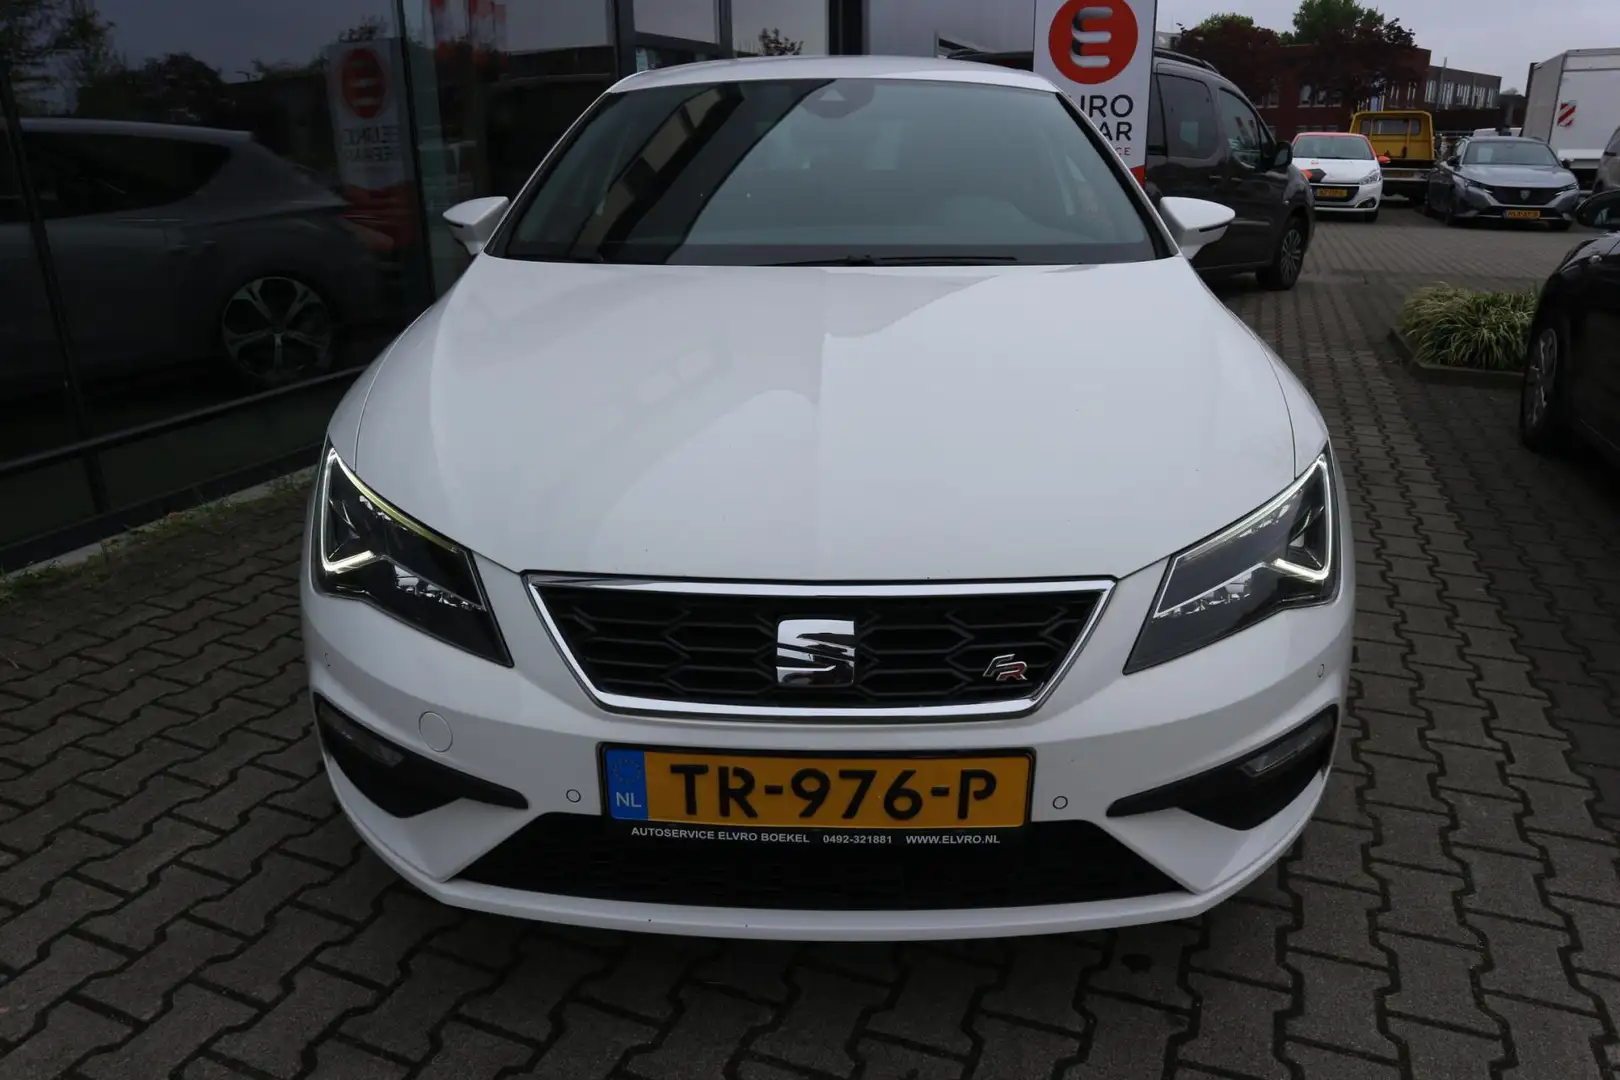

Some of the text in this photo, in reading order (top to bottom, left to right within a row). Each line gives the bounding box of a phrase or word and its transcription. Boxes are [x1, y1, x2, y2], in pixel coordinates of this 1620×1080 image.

[1099, 121, 1132, 141] AR
[982, 653, 1028, 681] FR
[615, 791, 642, 808] NL
[670, 764, 997, 821] TR-976-P
[631, 827, 1001, 844] AUTOSERVICE ELVRO BOEKEL 0492-321881 WWW.ELVRO.NL
